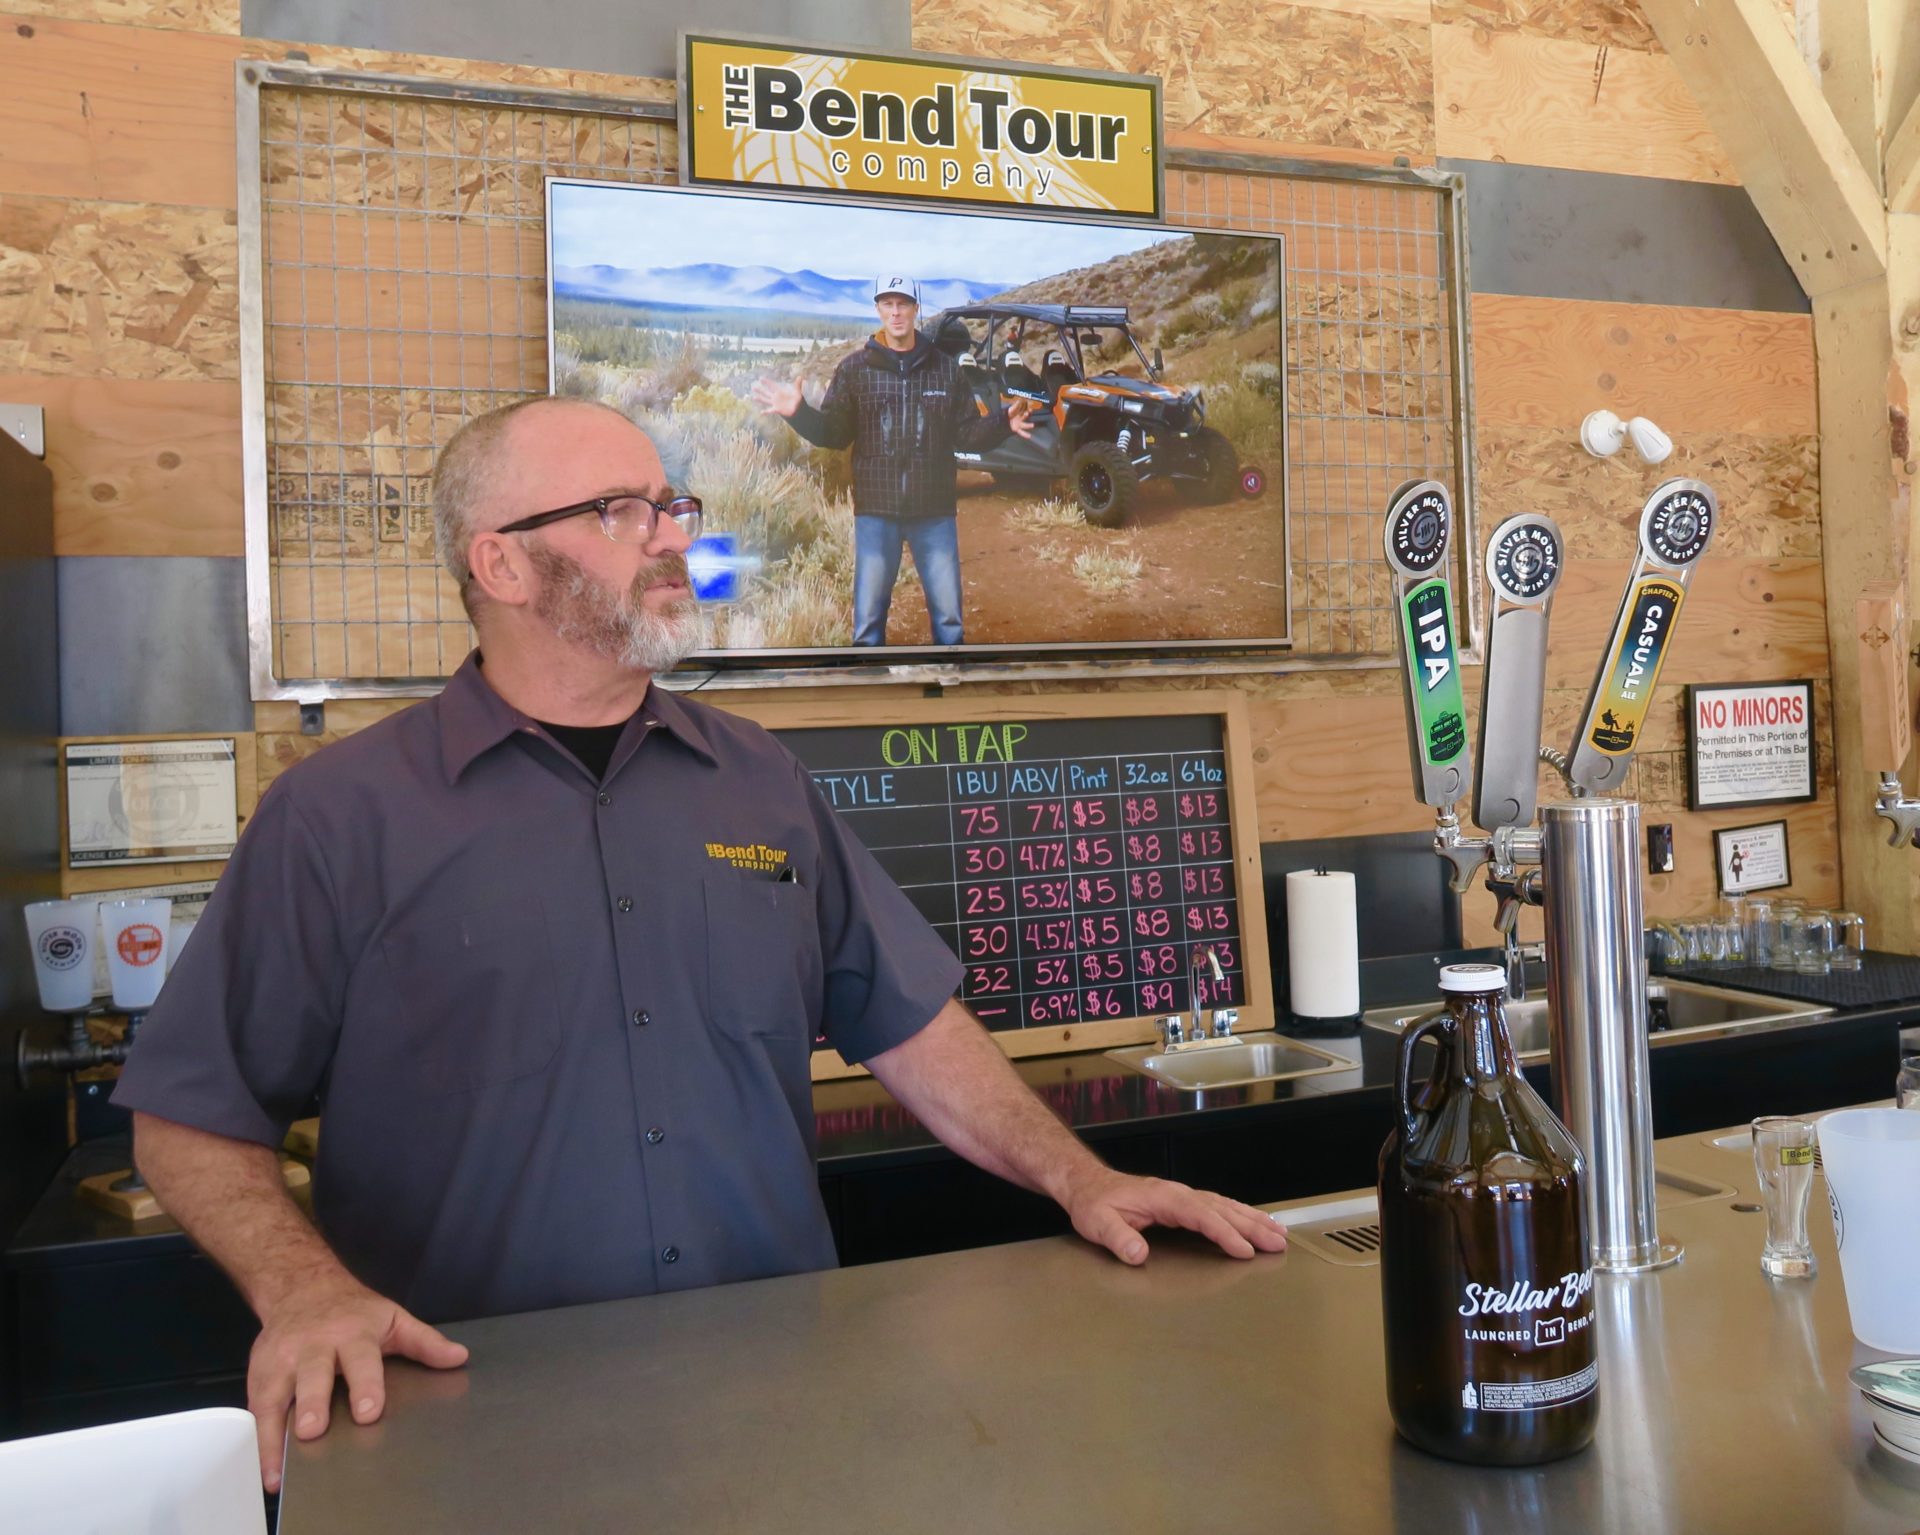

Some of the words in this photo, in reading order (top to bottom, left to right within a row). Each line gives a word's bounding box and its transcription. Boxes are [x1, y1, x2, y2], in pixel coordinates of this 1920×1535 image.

[723, 64, 751, 129] THE
[754, 65, 957, 147] Bend
[967, 86, 1126, 163] Tour
[831, 150, 1053, 195] company
[1398, 504, 1420, 549] SILVER
[1422, 496, 1446, 523] MOON
[1654, 496, 1688, 530] SILVER
[1691, 498, 1709, 536] MOON
[1406, 529, 1446, 563] BREWING
[1497, 530, 1527, 566] SILVER
[1531, 530, 1554, 566] MOON
[1655, 537, 1700, 559] BREWING
[1501, 572, 1550, 593] BREWING
[1641, 588, 1674, 599] CHAPTER
[1418, 607, 1450, 690] IPA
[1623, 604, 1663, 689] CASUAL
[1620, 690, 1637, 701] ALE
[1699, 700, 1727, 729] NO
[1732, 695, 1804, 727] MINORS
[881, 728, 938, 767] ON
[946, 723, 1028, 764] TAP
[1697, 735, 1737, 746] Permitted
[1738, 734, 1746, 743] in
[1748, 733, 1766, 743] This
[1767, 731, 1798, 742] Portion
[1799, 730, 1809, 740] of
[1698, 750, 1713, 760] The
[1714, 748, 1753, 760] Premises
[1754, 748, 1764, 756] or
[1765, 747, 1773, 756] at
[1774, 746, 1792, 755] This
[1793, 744, 1808, 754] Bar
[957, 770, 998, 795] IBU
[1010, 766, 1060, 794] ABV
[1069, 764, 1108, 790] Pint
[1124, 763, 1169, 786] 32oz
[1181, 759, 1223, 782] 64oz
[961, 806, 1000, 836] 75
[1027, 803, 1065, 832] 7%
[1072, 799, 1107, 828] $5
[1125, 797, 1159, 824] $8
[1180, 794, 1219, 818] $13
[713, 843, 757, 860] Bend
[757, 845, 787, 863] Tour
[732, 859, 775, 872] company
[964, 846, 1006, 873] 30
[1020, 842, 1066, 872] 4.7%
[1073, 838, 1113, 866] $5
[1128, 835, 1161, 862] $8
[1181, 830, 1222, 855] $13
[966, 886, 1006, 914] 25
[1021, 882, 1070, 911] 5.3%
[1076, 877, 1117, 904] $5
[1130, 872, 1163, 900] $8
[1183, 868, 1225, 894] $13
[968, 925, 1008, 956] 30
[1025, 920, 1076, 951] 4.5%
[1079, 917, 1120, 947] $5
[1134, 909, 1170, 937] $8
[1187, 906, 1229, 931] $13
[973, 967, 1012, 994] 32
[1035, 959, 1070, 986] 5%
[1083, 952, 1124, 980] $5
[1138, 945, 1177, 975] $8
[1030, 992, 1077, 1021] 6.9%
[1085, 989, 1121, 1016] $6
[1141, 982, 1174, 1009] $9
[1458, 1279, 1560, 1317] Stellar
[1464, 1328, 1531, 1341] LAUNCHED
[1545, 1326, 1557, 1338] IN
